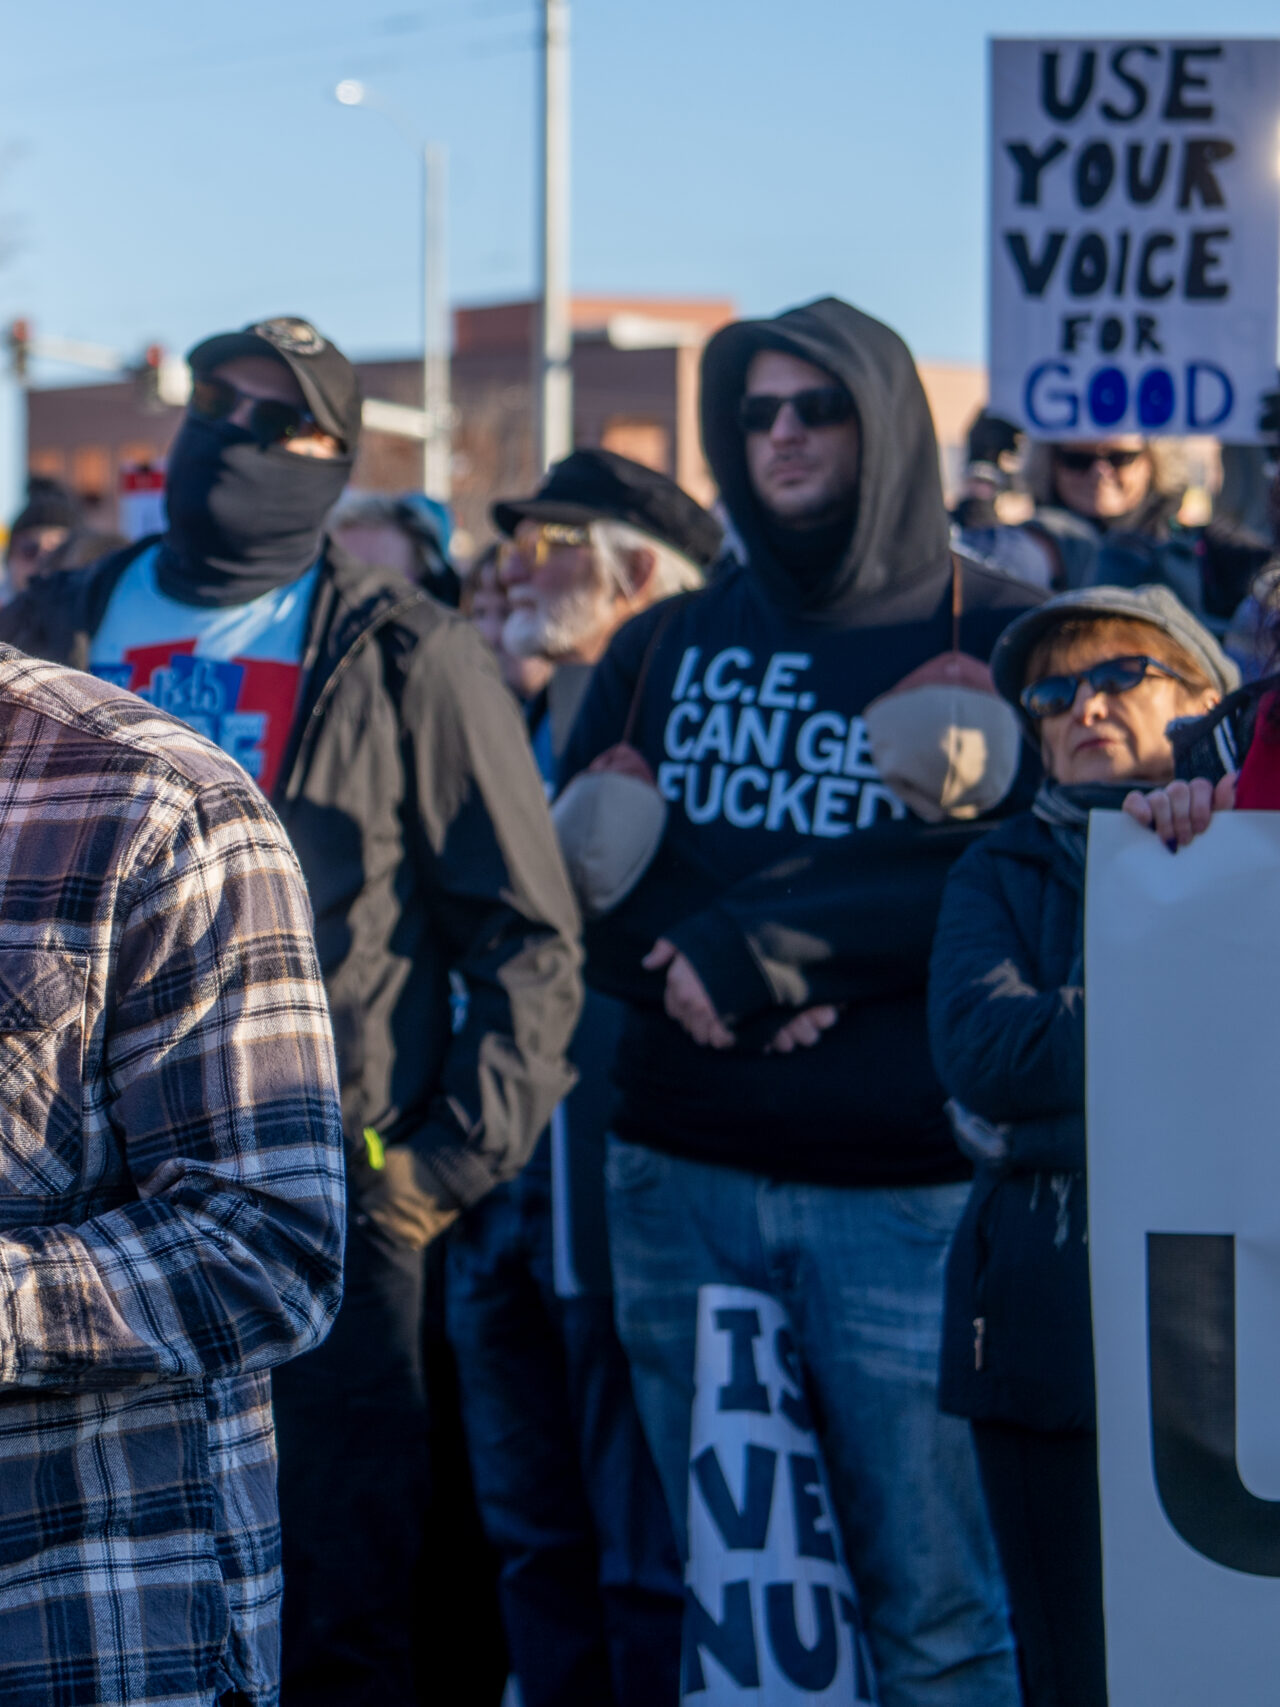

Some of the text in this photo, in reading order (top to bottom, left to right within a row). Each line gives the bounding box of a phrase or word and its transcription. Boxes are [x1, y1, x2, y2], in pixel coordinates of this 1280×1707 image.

[1041, 45, 1222, 123] USE
[1005, 137, 1235, 210] YOUR
[1005, 227, 1231, 299] VOICE
[1061, 313, 1163, 355] FOR
[1024, 359, 1234, 431] GOOD
[671, 646, 816, 710] I.C.E.
[663, 703, 880, 779] CAN GE
